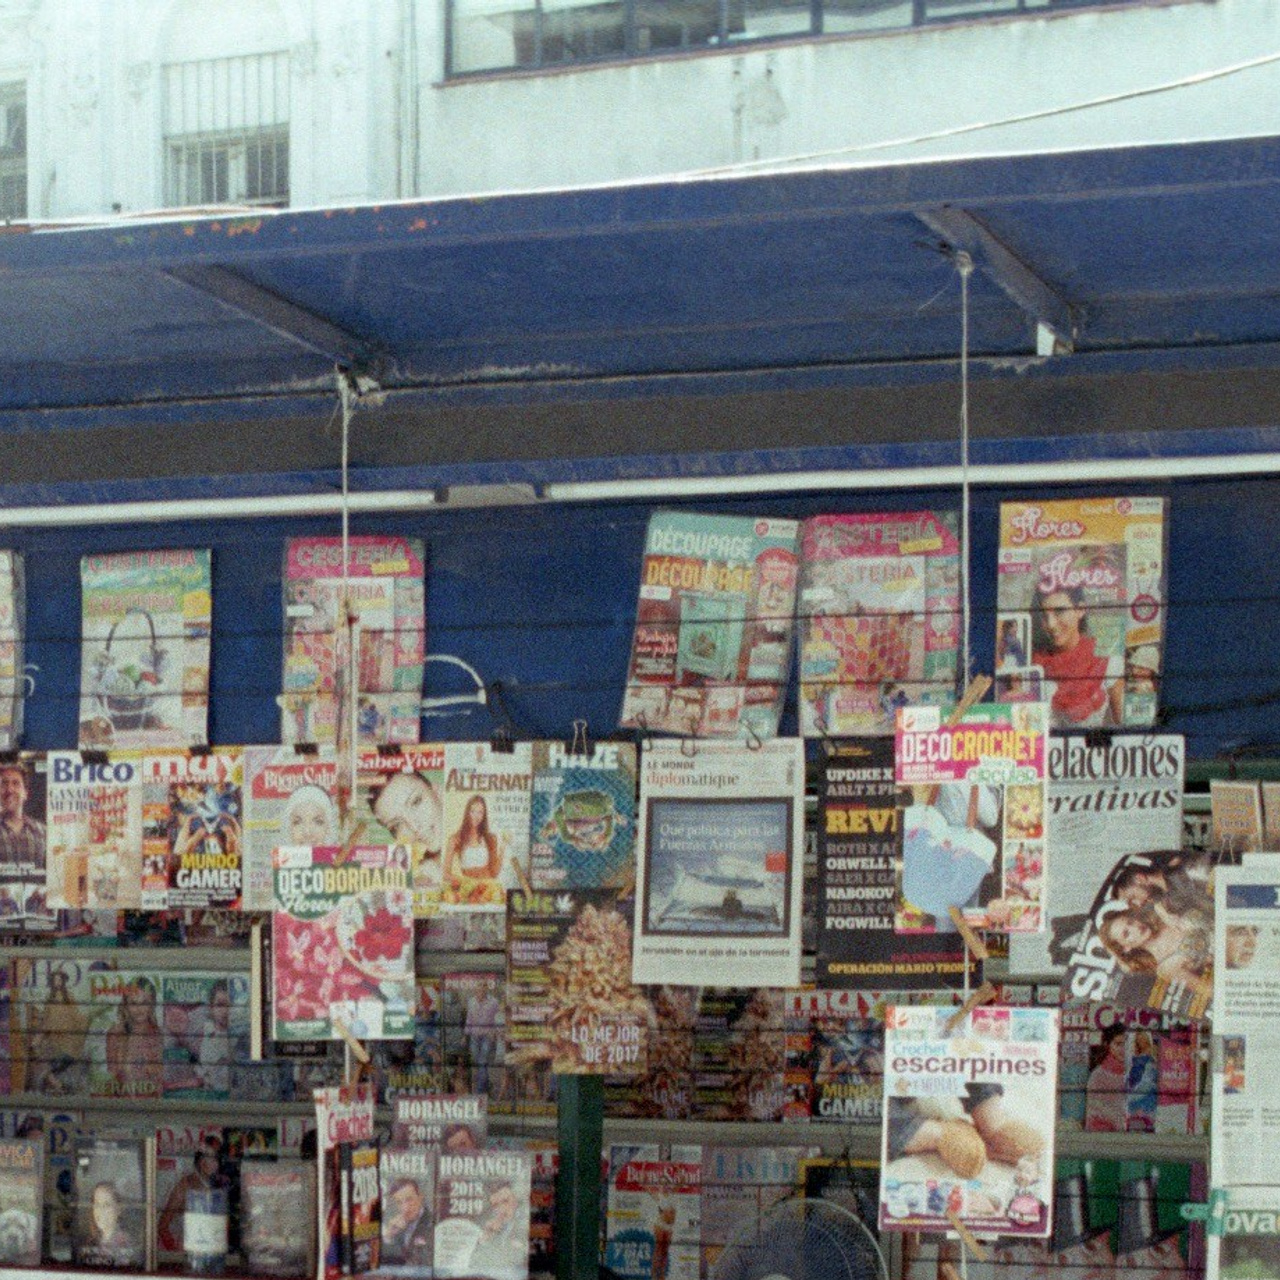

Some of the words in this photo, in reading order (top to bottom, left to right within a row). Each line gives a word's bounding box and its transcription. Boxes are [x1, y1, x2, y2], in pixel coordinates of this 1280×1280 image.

[53, 758, 133, 785] Brico
[143, 753, 245, 784] muy
[180, 852, 239, 869] MUNDO
[176, 868, 242, 890] GAMER
[826, 887, 895, 900] NABOKOV
[826, 916, 892, 930] FOGWILL
[607, 1044, 640, 1063] 2017
[891, 1052, 1047, 1084] escarpines
[398, 1099, 482, 1120] HORANGEL
